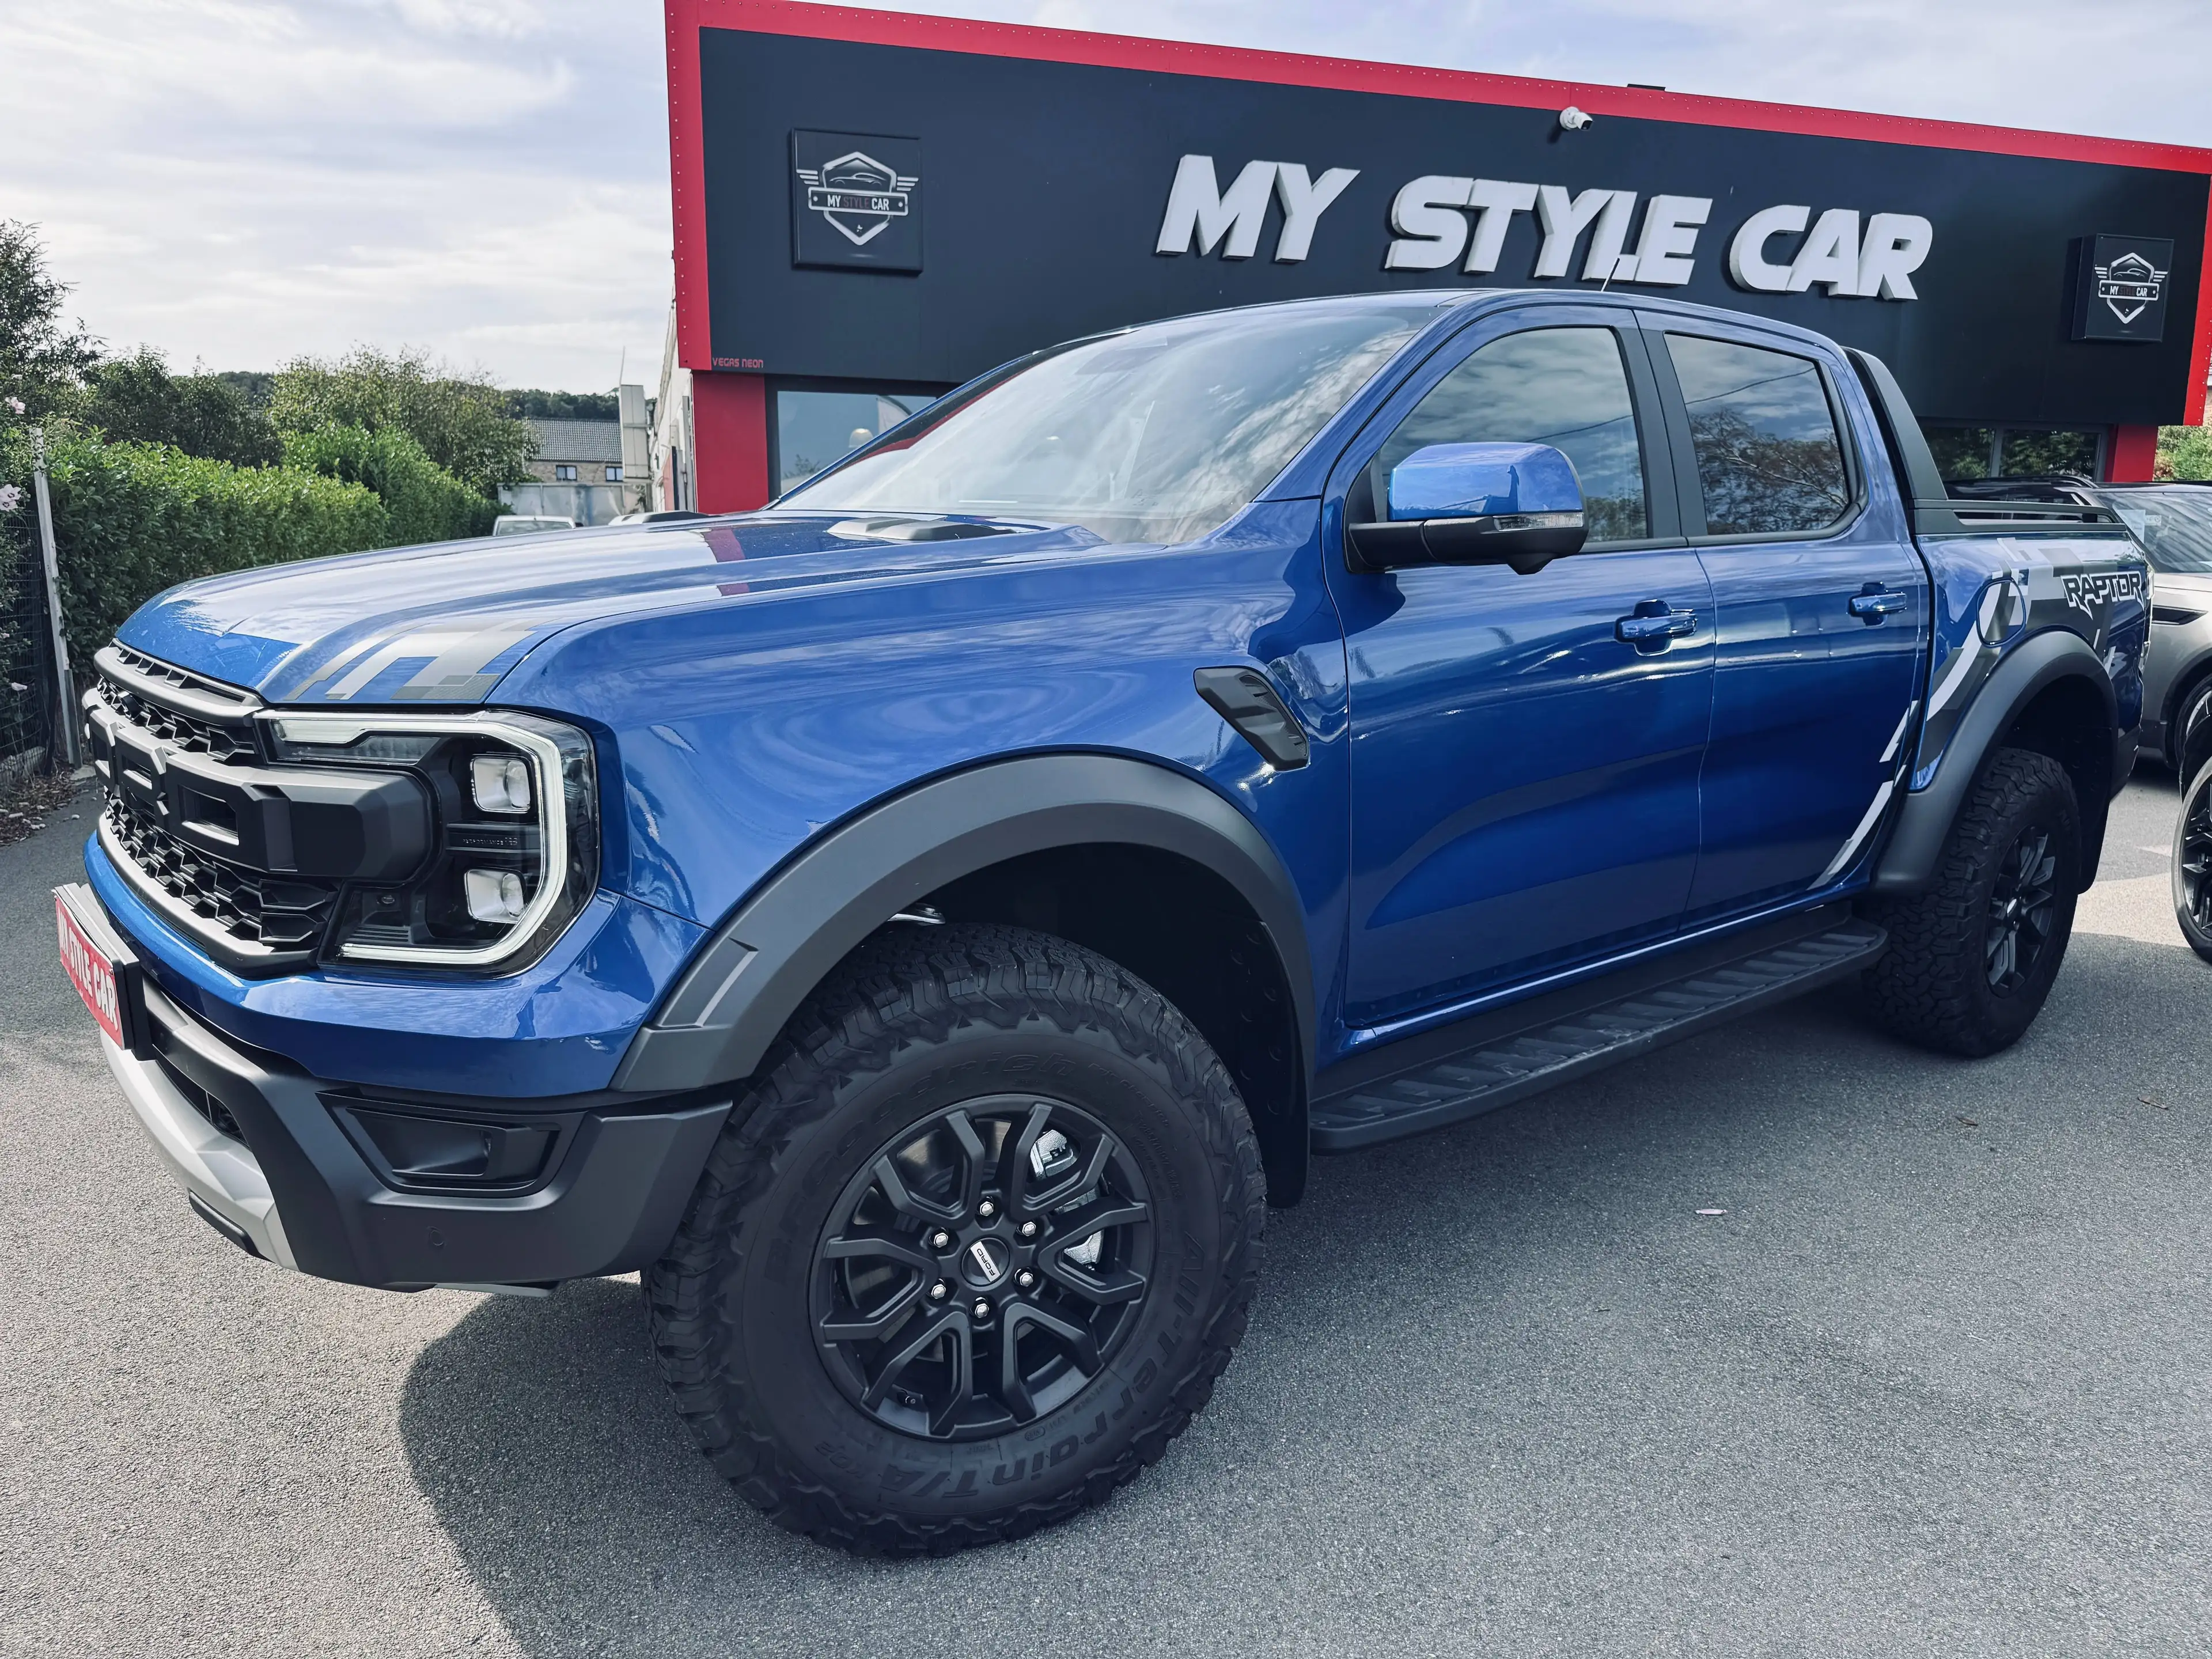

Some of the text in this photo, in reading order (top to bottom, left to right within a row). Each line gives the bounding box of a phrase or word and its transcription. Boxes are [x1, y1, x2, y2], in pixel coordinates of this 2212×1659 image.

[827, 194, 889, 211] MY STYLE CAR
[1156, 154, 1933, 300] MY STYLE CAR
[2109, 285, 2119, 296] MY
[2136, 287, 2148, 297] CAR
[713, 357, 740, 368] VEGAS
[2060, 570, 2145, 620] RAPTOR
[69, 926, 93, 998] STYLE
[94, 961, 119, 1032] CAR
[976, 1248, 996, 1277] FORD
[878, 1463, 980, 1498] T/A
